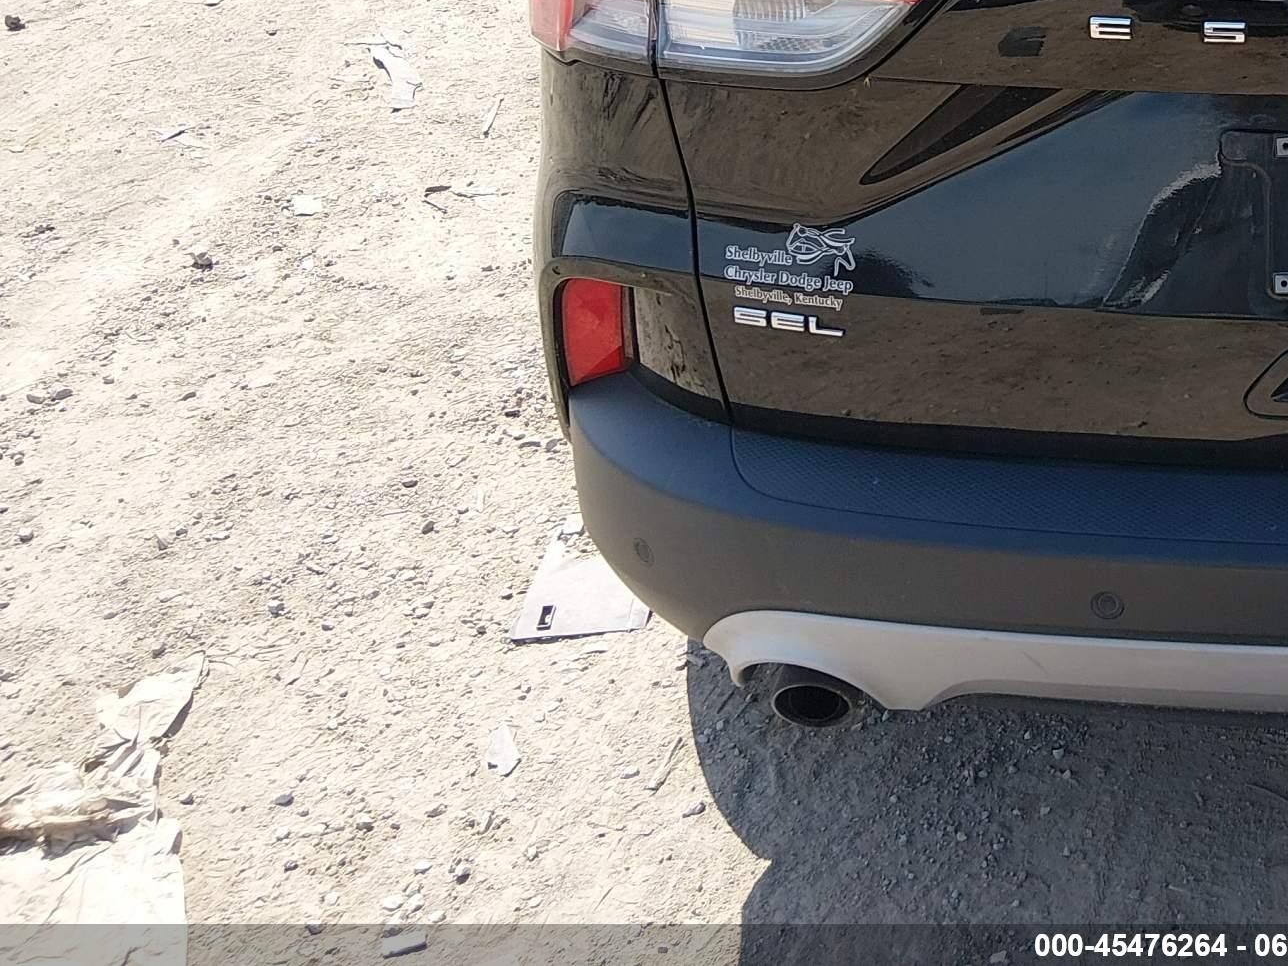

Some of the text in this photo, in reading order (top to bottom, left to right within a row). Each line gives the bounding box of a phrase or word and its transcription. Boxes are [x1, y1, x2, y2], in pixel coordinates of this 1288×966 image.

[725, 245, 793, 267] Shelbyville
[724, 265, 854, 295] Chrysler Dodge Jeep
[734, 285, 844, 311] Shelbyville, Kentucky
[733, 306, 844, 337] SEL
